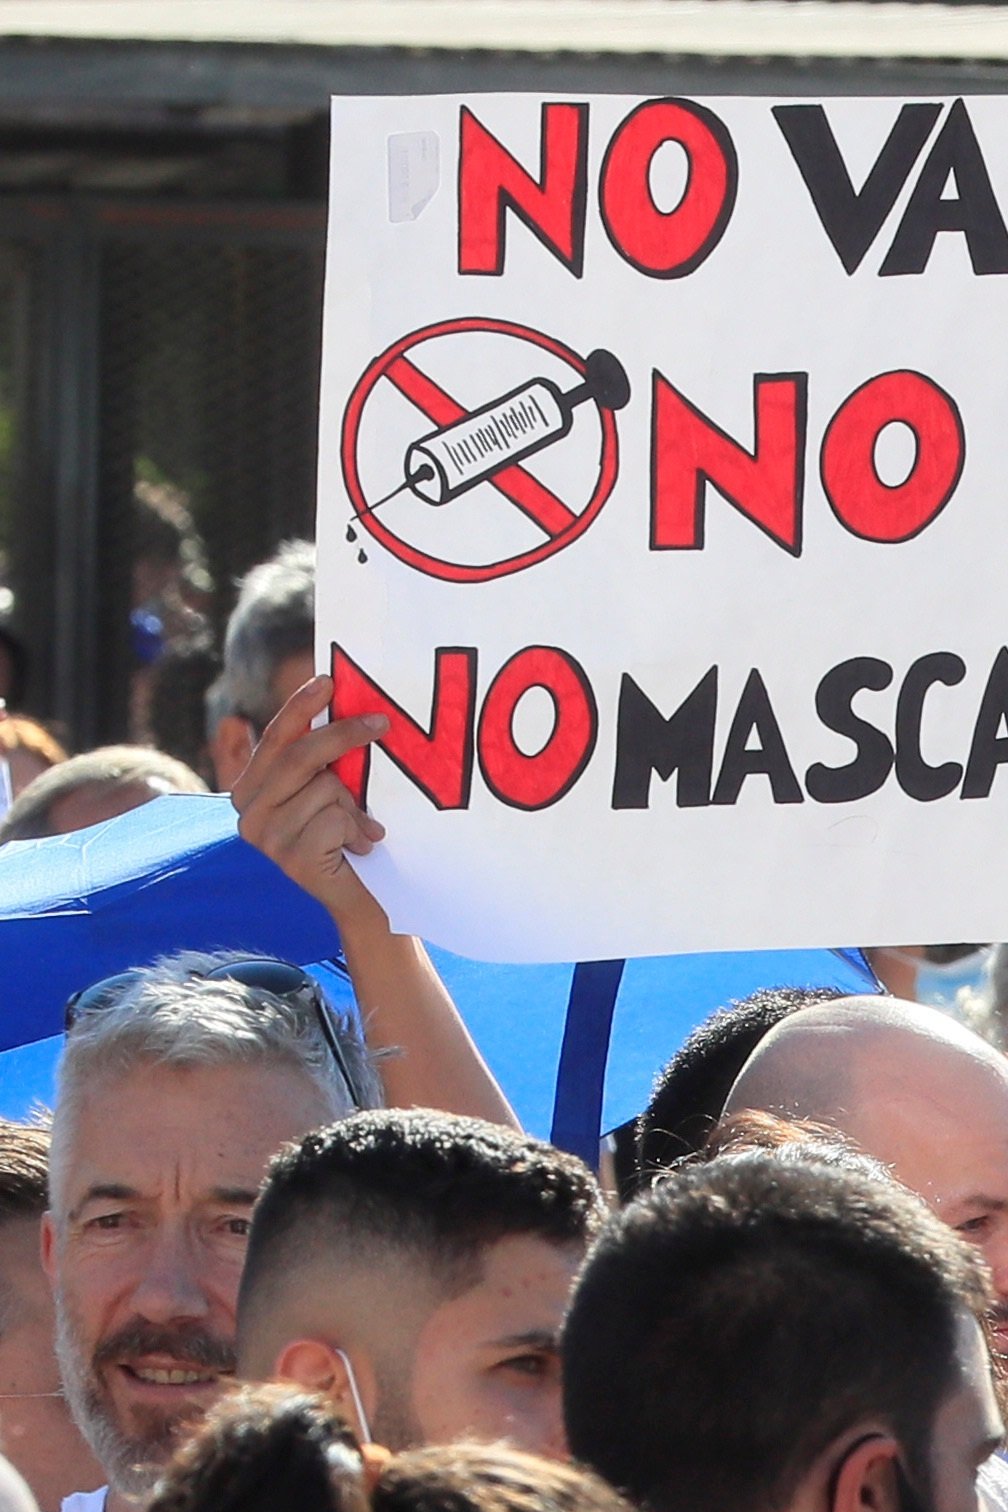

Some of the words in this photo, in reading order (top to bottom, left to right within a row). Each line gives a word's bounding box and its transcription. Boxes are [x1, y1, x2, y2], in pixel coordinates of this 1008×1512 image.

[458, 97, 739, 280] NO
[649, 368, 966, 558] NO
[329, 641, 599, 811] NO
